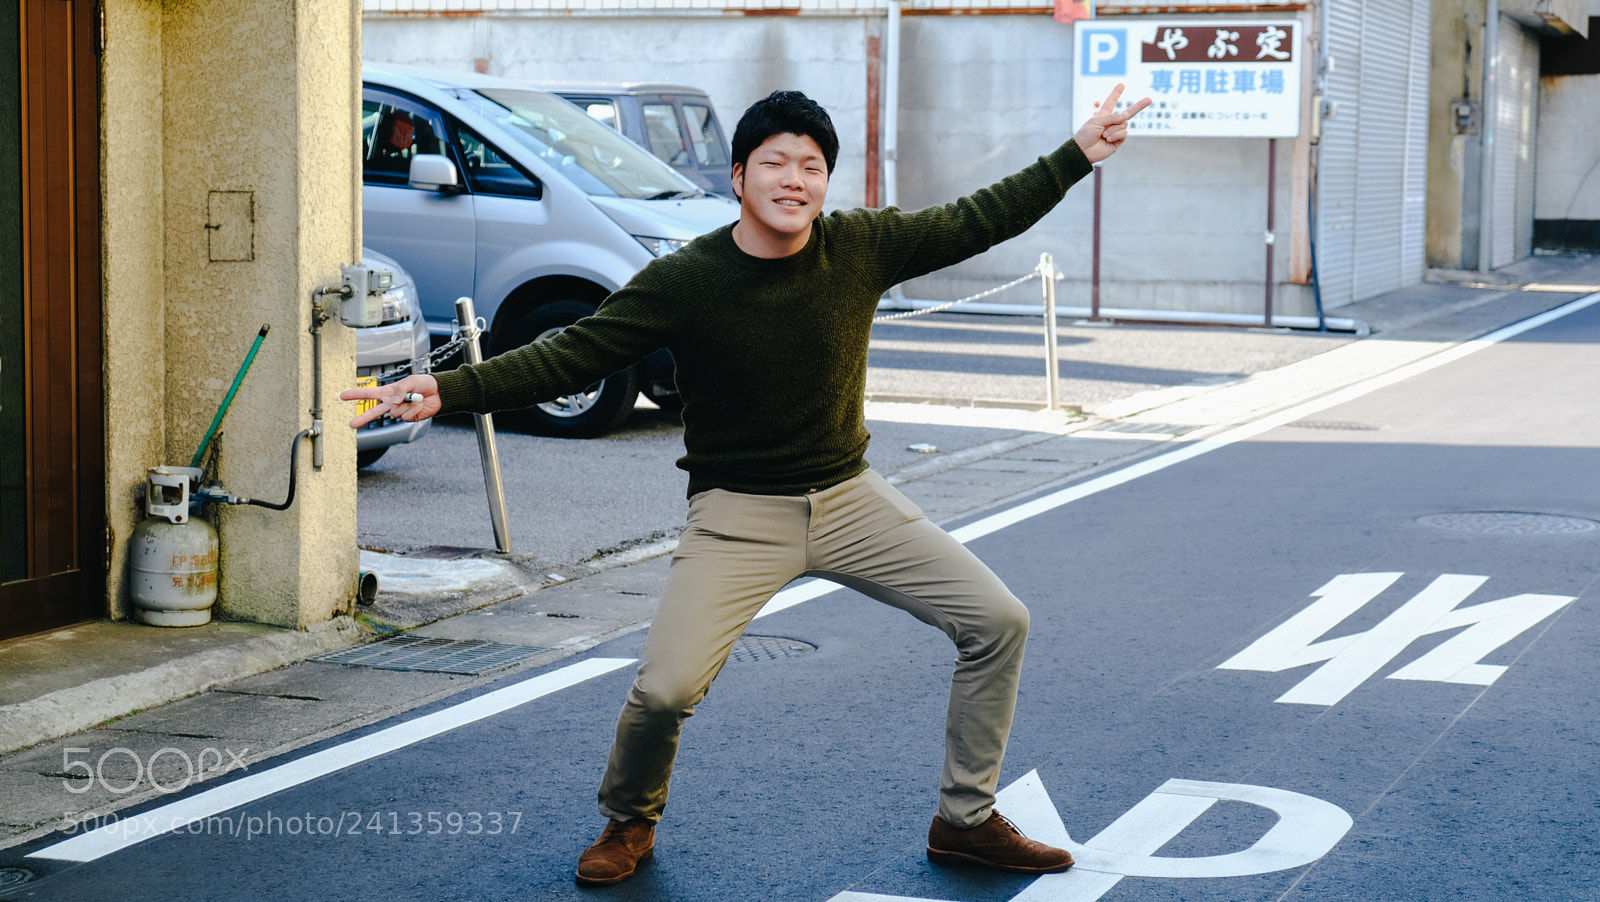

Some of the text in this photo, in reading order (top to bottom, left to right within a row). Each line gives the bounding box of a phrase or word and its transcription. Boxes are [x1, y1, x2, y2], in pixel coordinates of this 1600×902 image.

[1088, 33, 1119, 73] P
[1157, 25, 1290, 60] やぶ定
[1150, 69, 1284, 94] 専用駐車場
